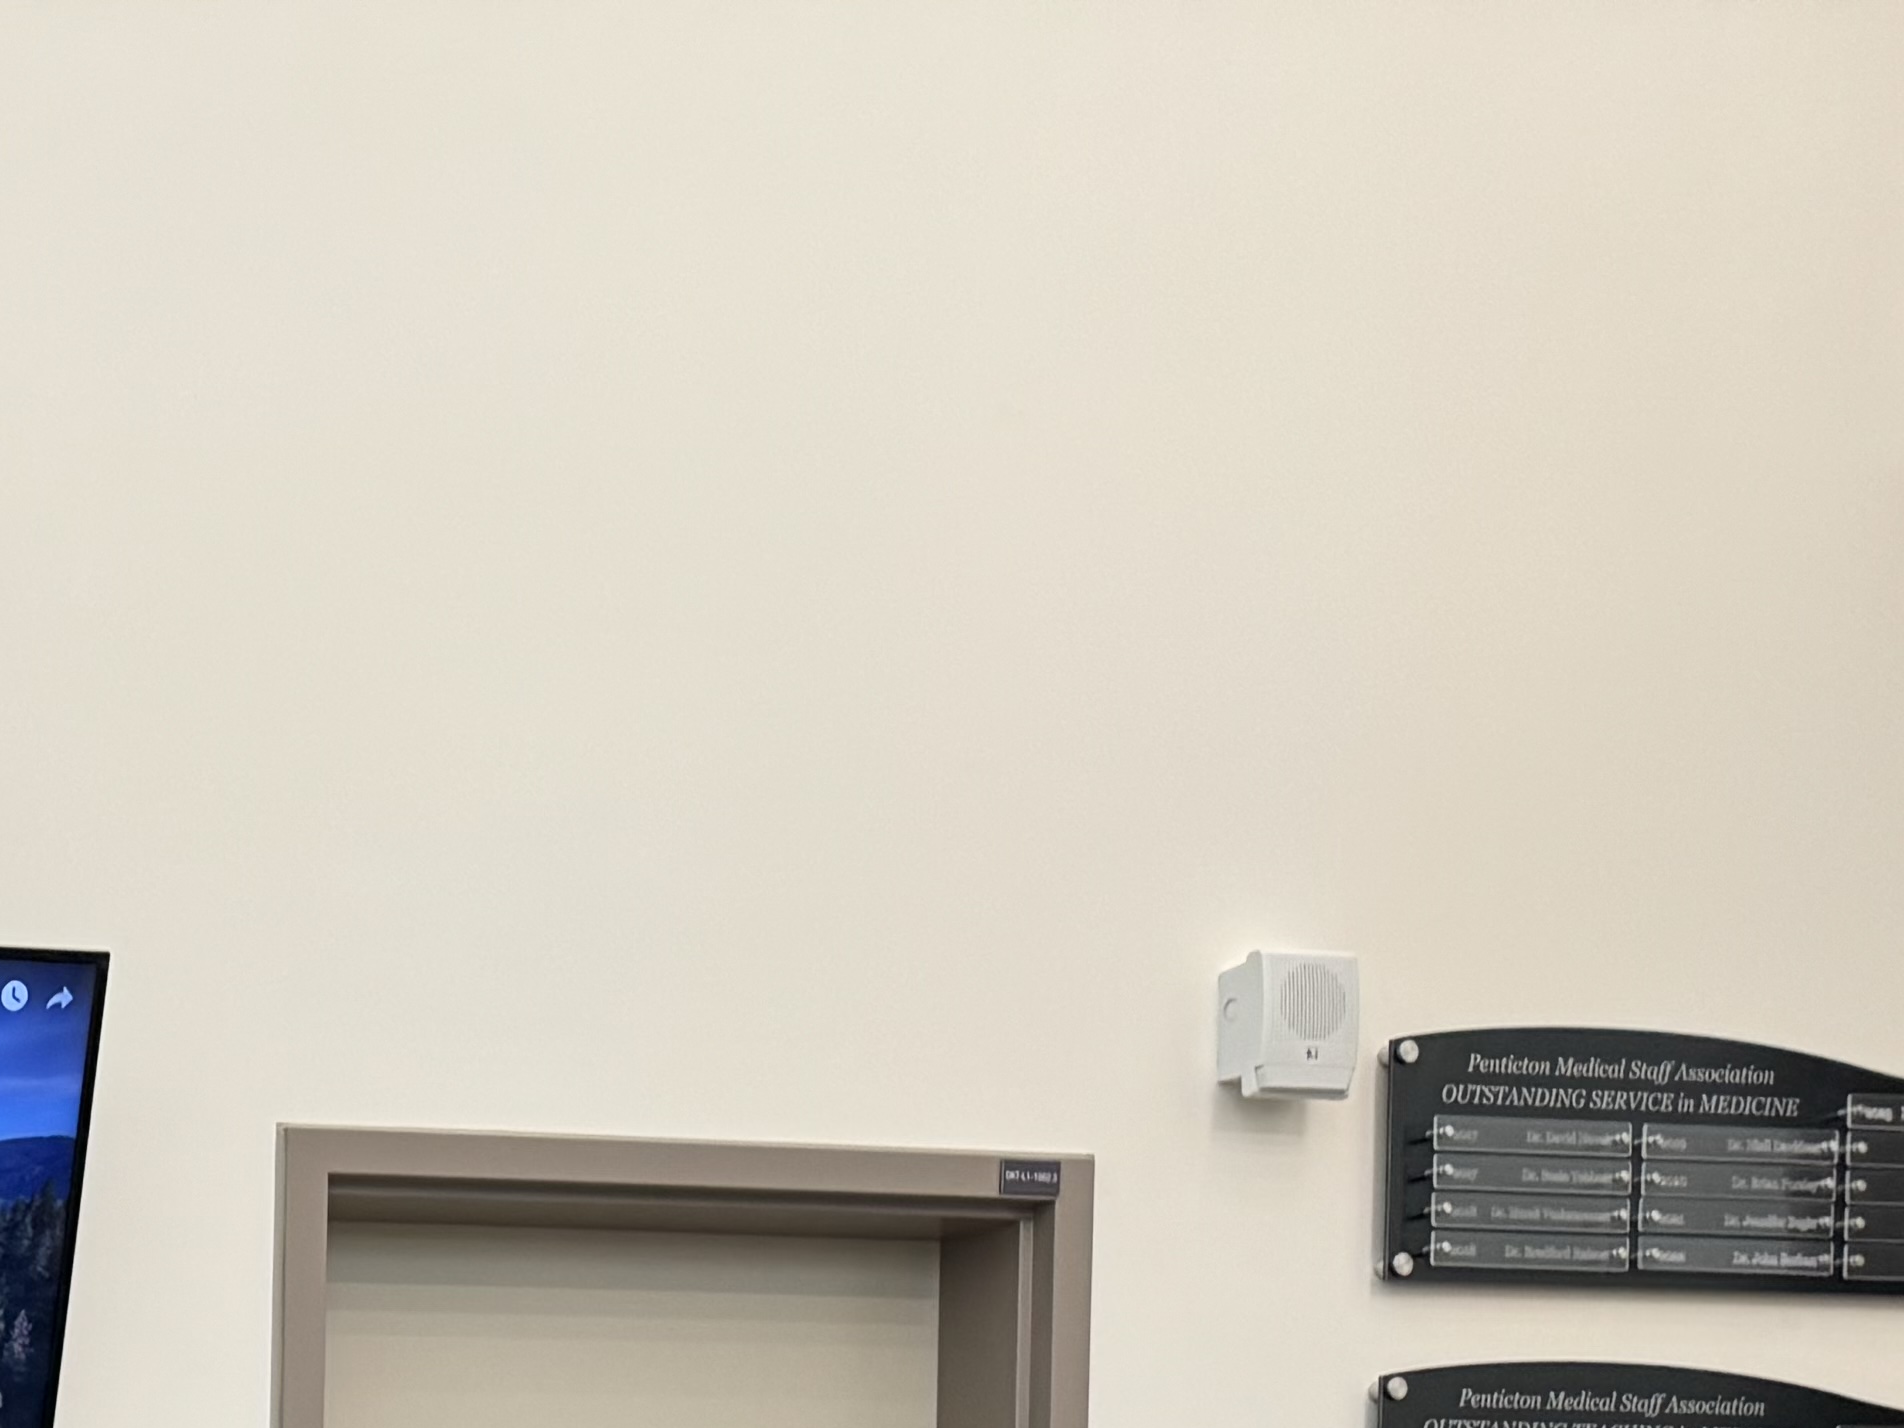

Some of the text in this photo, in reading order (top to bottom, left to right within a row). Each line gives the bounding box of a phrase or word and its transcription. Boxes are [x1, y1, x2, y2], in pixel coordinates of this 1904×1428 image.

[1468, 1053, 1774, 1085] Penticton Medical Staff Association
[1442, 1083, 1800, 1117] OUTSTANDING SERVICE in MEDICINE
[1459, 1388, 1765, 1418] Penticton Medical Staff Association
